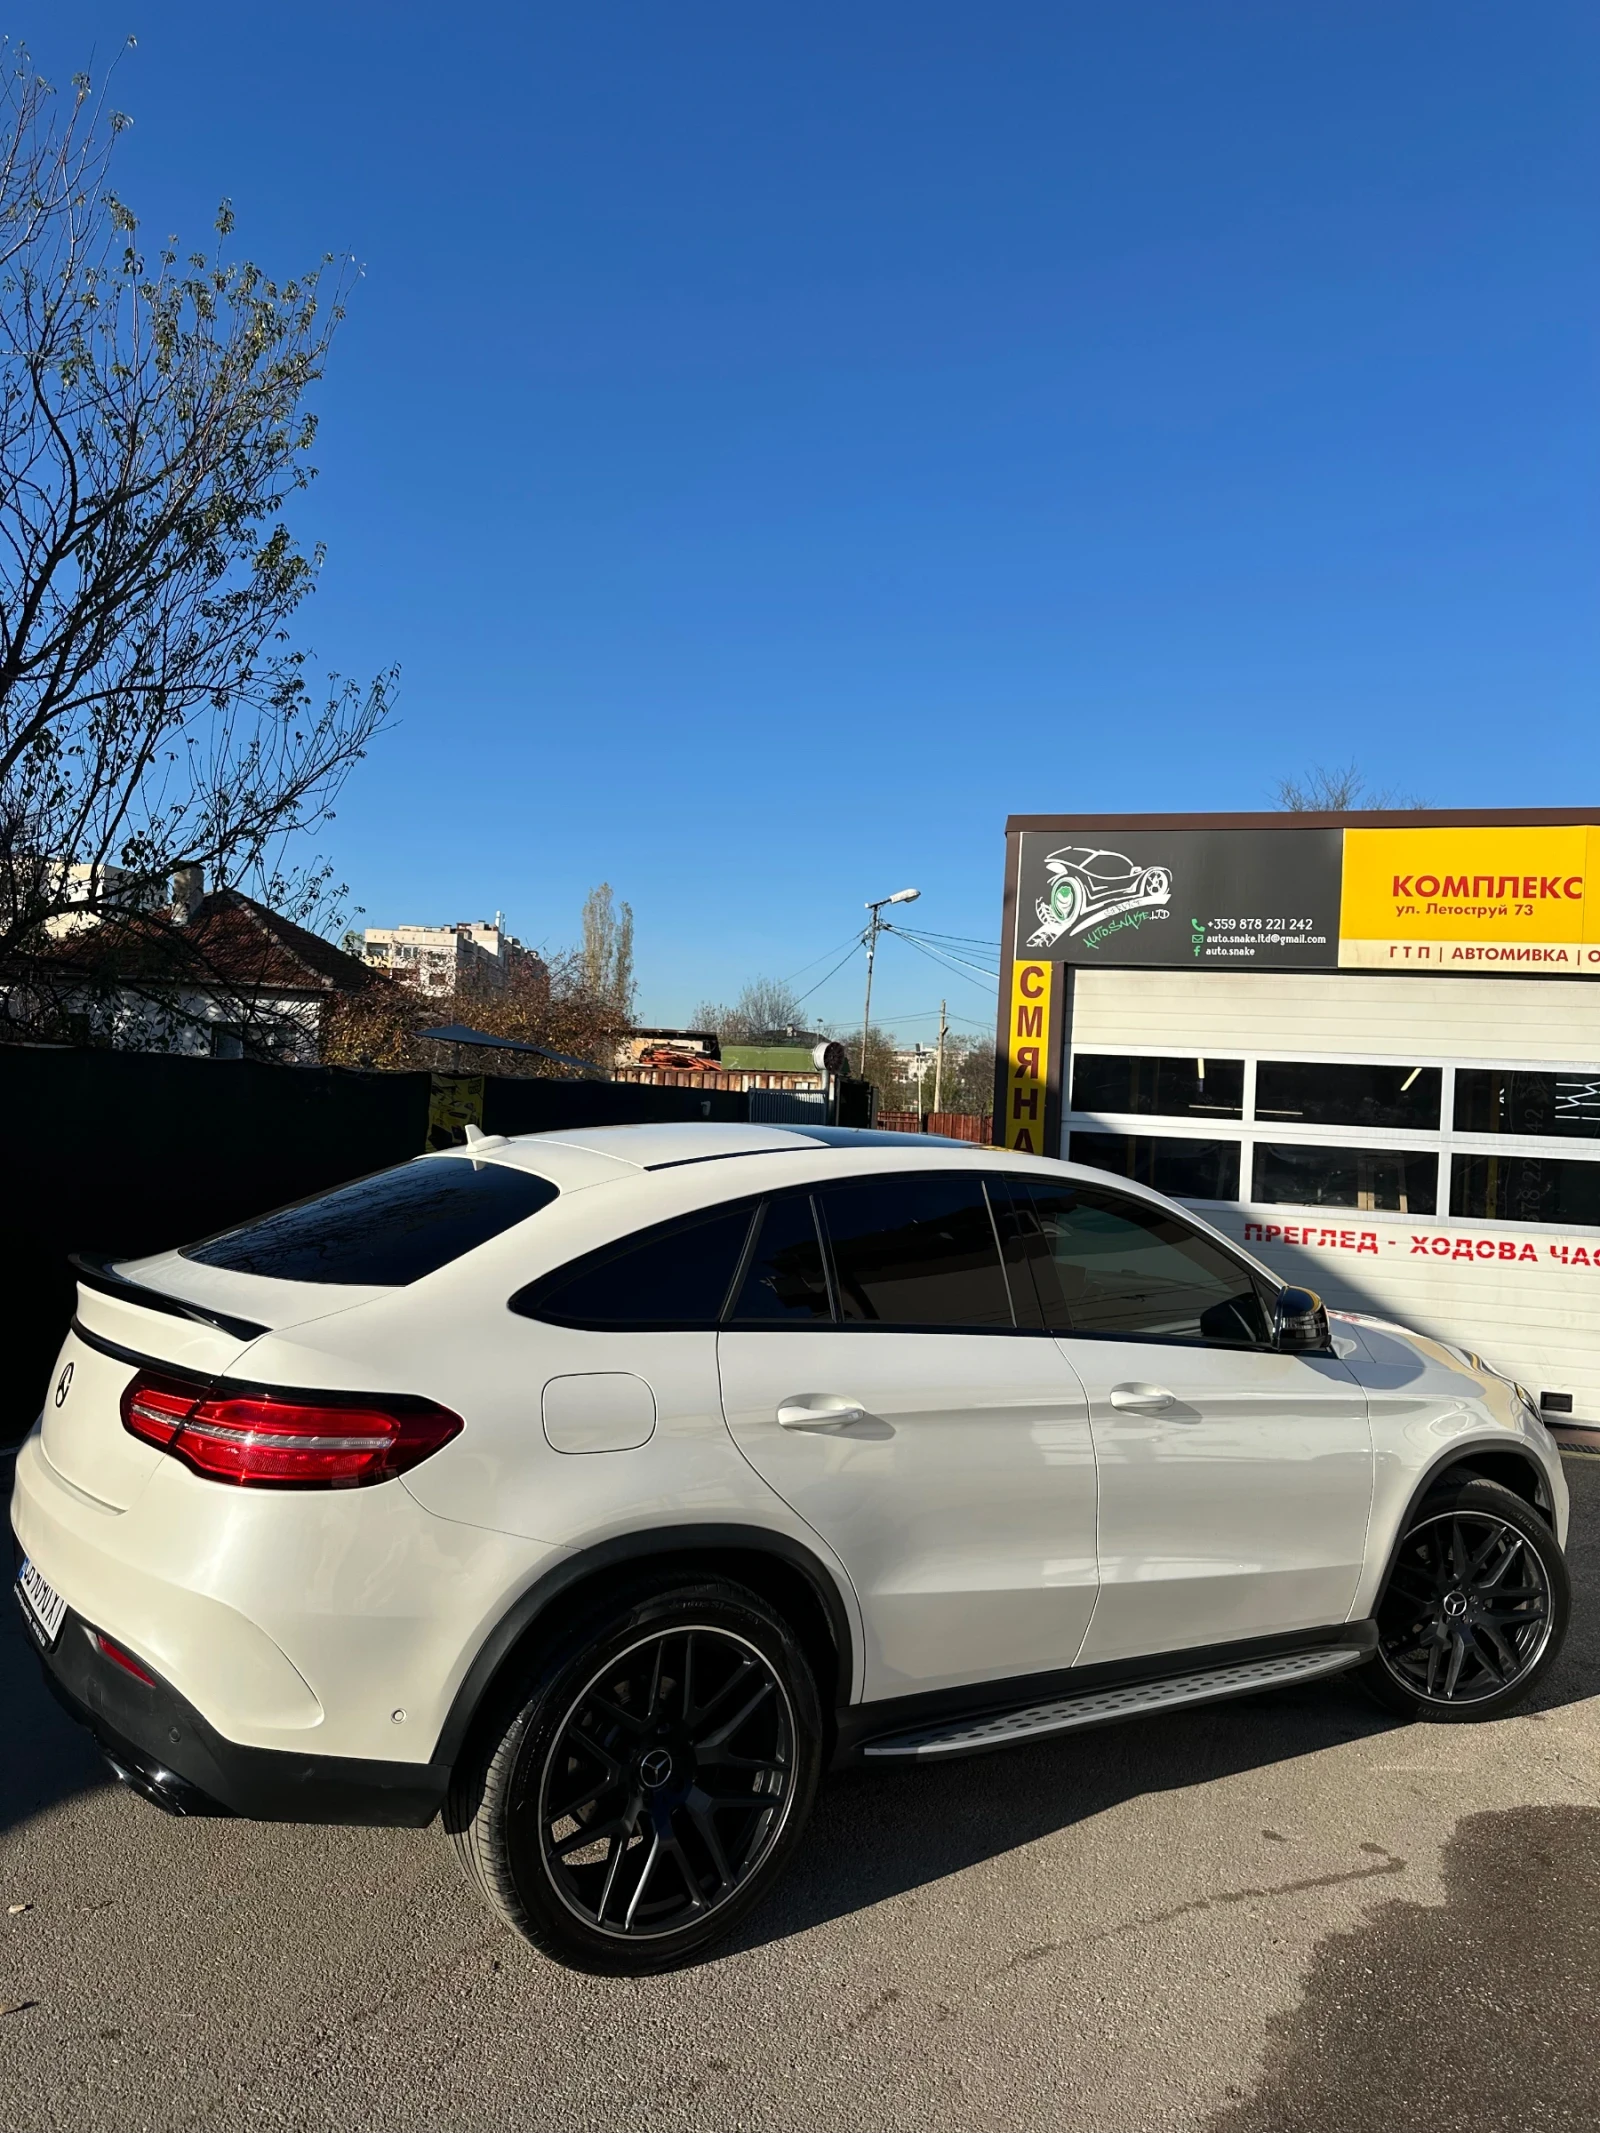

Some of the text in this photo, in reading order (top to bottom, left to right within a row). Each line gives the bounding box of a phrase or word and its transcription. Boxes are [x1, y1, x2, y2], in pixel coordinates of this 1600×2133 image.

[1392, 875, 1583, 899] КОМПЛЕКС
[1396, 902, 1534, 918] ул. Летоструй 73
[1207, 918, 1313, 930] +359 878 221 242
[1206, 933, 1327, 946] auto.snake.ltd@gmail.com
[1205, 946, 1255, 956] auto.snake
[1451, 947, 1568, 962] АВТОМИВКА
[1244, 1223, 1379, 1255] ПРЕГЛЕД
[1410, 1235, 1539, 1262] ХОДОВА
